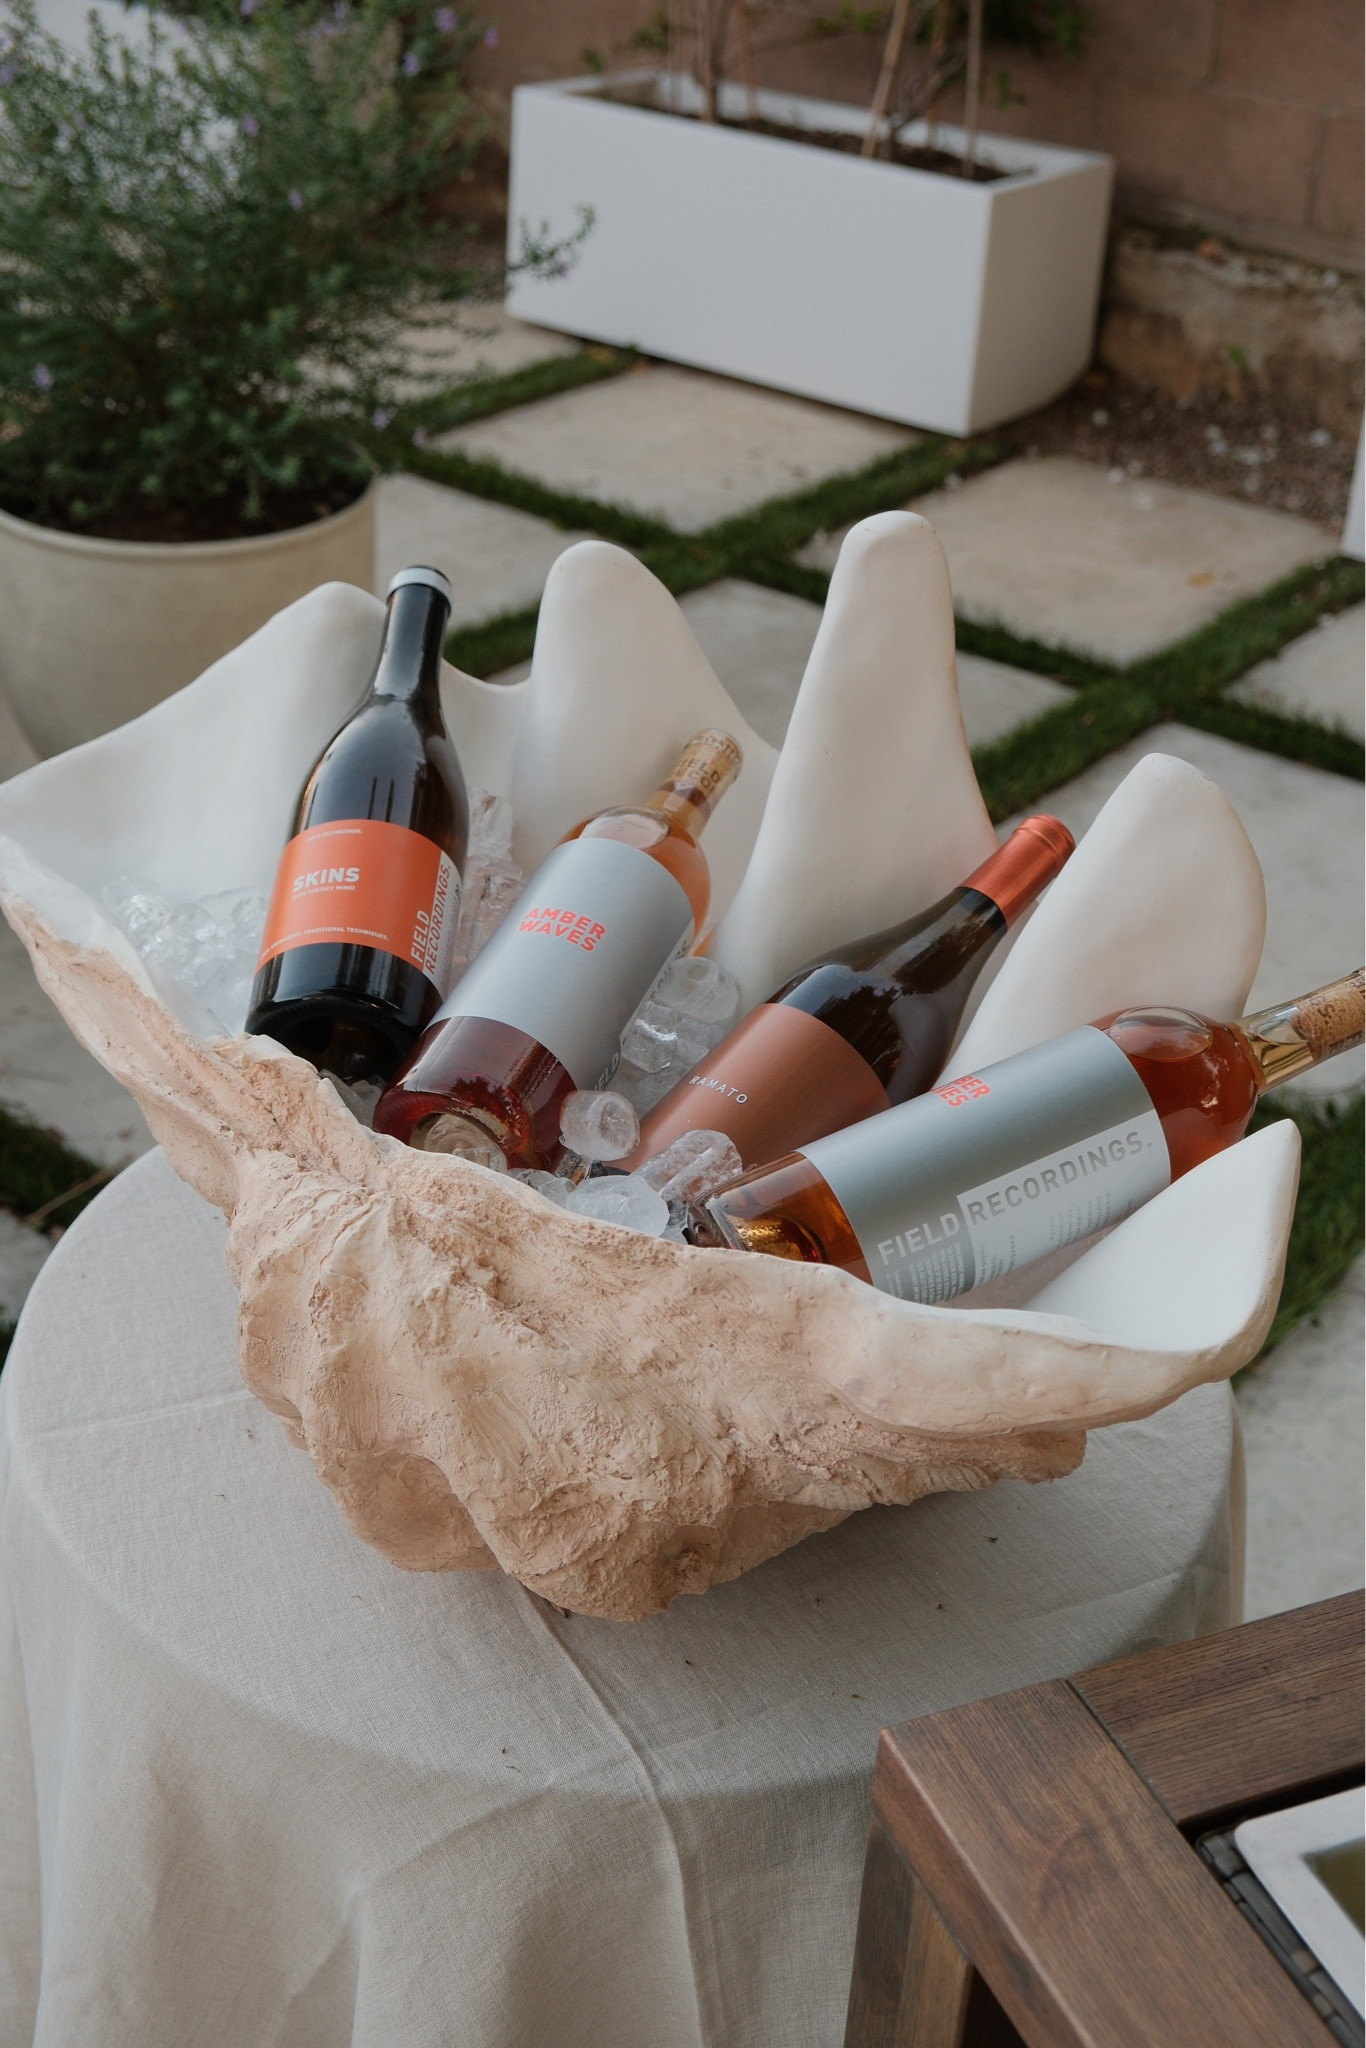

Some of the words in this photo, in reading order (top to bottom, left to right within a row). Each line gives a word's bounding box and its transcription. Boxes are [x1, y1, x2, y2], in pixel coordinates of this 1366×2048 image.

[292, 867, 360, 892] SKINS
[304, 926, 345, 935] TRADITIONAL
[425, 864, 451, 975] RECORDINGS.
[525, 908, 606, 941] AMBER
[411, 910, 430, 963] FIELD
[519, 921, 598, 952] WAVES
[689, 1076, 748, 1104] RAMATO
[878, 1213, 960, 1266] FIELD
[967, 1131, 1153, 1225] RECORDINGS.
